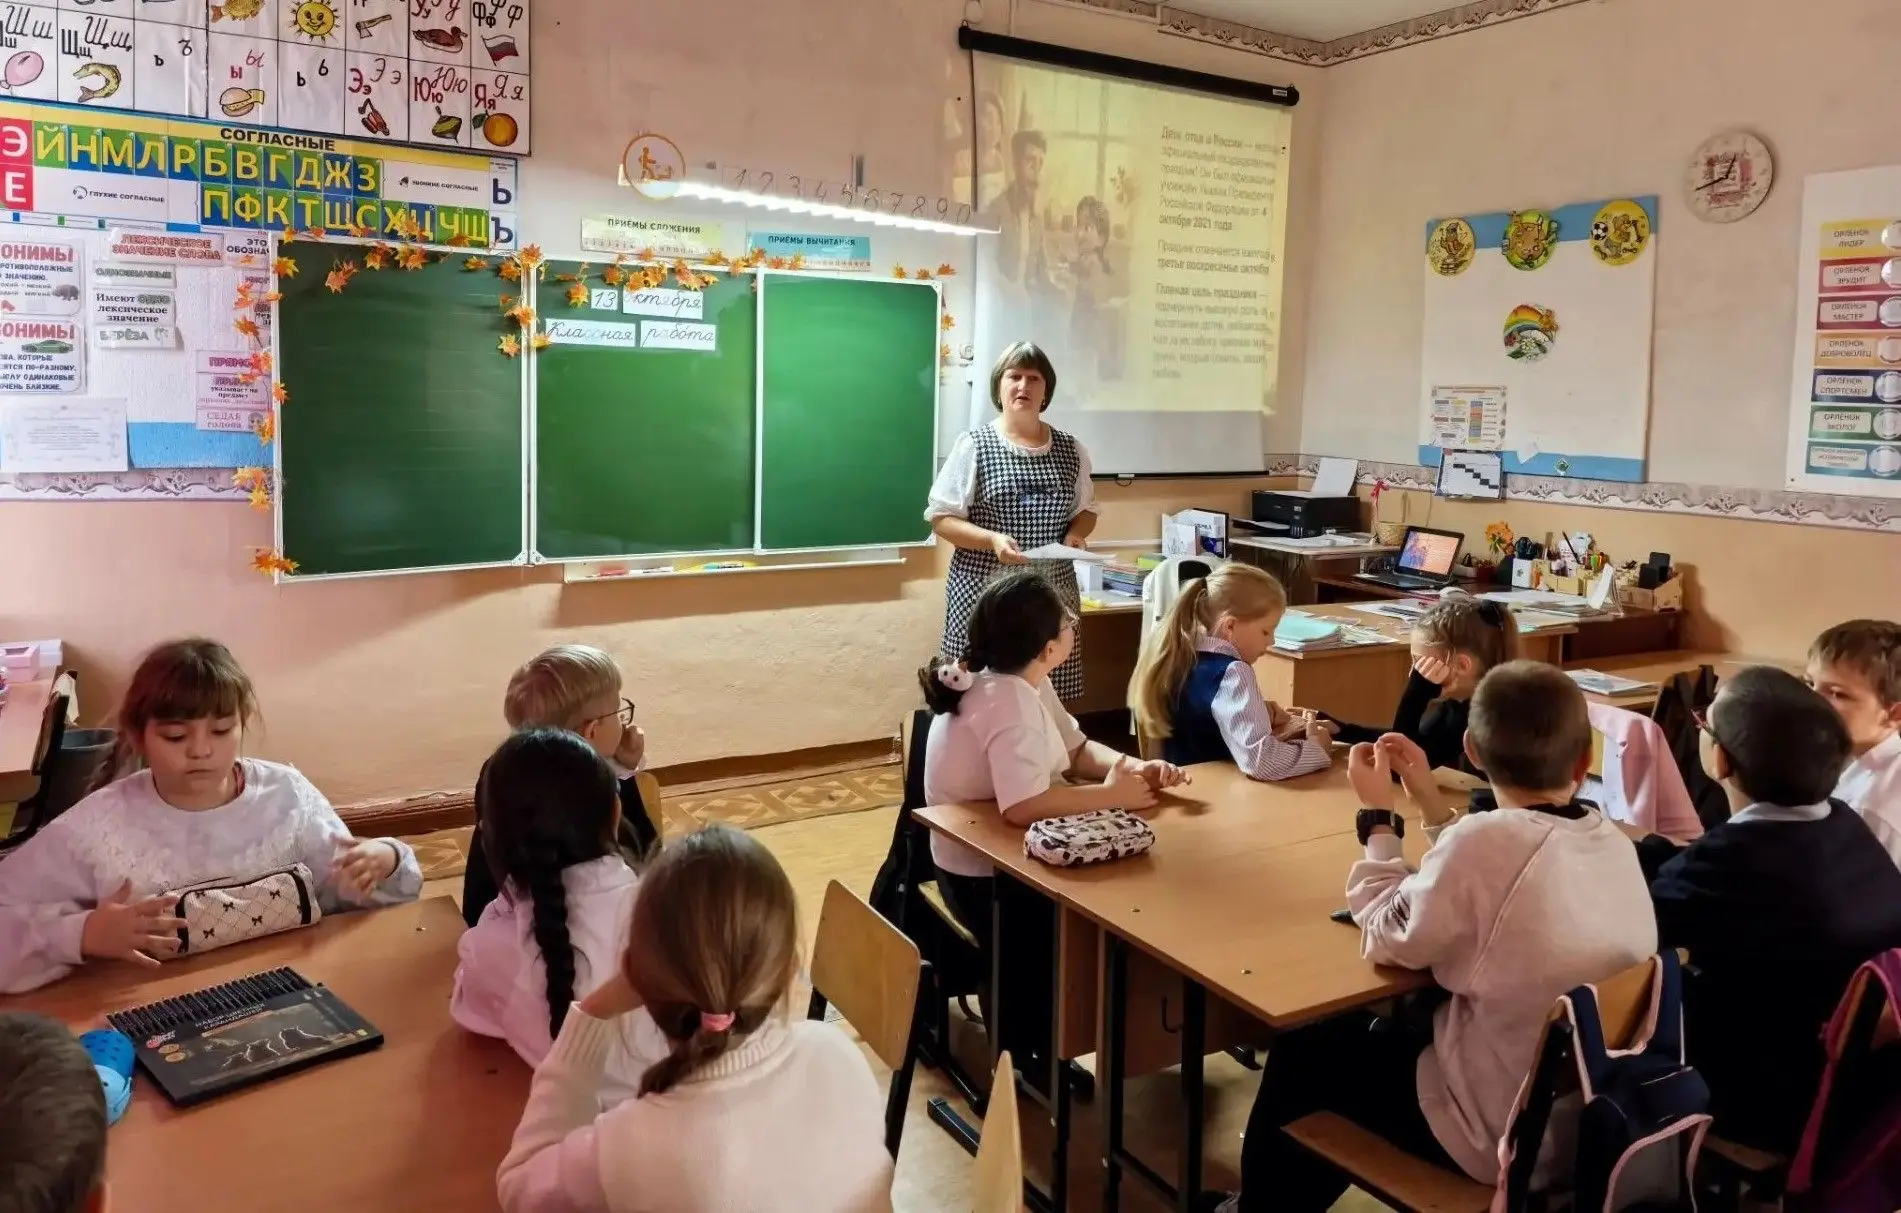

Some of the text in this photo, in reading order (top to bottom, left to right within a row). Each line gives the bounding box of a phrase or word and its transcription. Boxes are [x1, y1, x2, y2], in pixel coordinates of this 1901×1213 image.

[1, 125, 28, 157] Э
[220, 127, 336, 151] СОГЛАСНЫЕ
[4, 172, 27, 203] Е
[441, 183, 479, 192] СОГЛАСНЫЕ
[89, 190, 165, 203] ГЛУХИЕ СОГЛАСНЫЕ
[650, 222, 701, 234] СЛОЖЕНИЯ
[121, 234, 212, 248] ЛЕКСИЧЕСКОЕ
[247, 239, 267, 247] ЭТО
[112, 244, 224, 260] ЗНАЧЕНИЕ СЛОВА
[96, 293, 135, 303] Имеют
[595, 290, 702, 317] 13 ктбря
[97, 305, 168, 314] лексическое
[107, 315, 159, 323] значение
[1833, 313, 1865, 321] МАСТЕР
[547, 322, 714, 348] Кланая рбота
